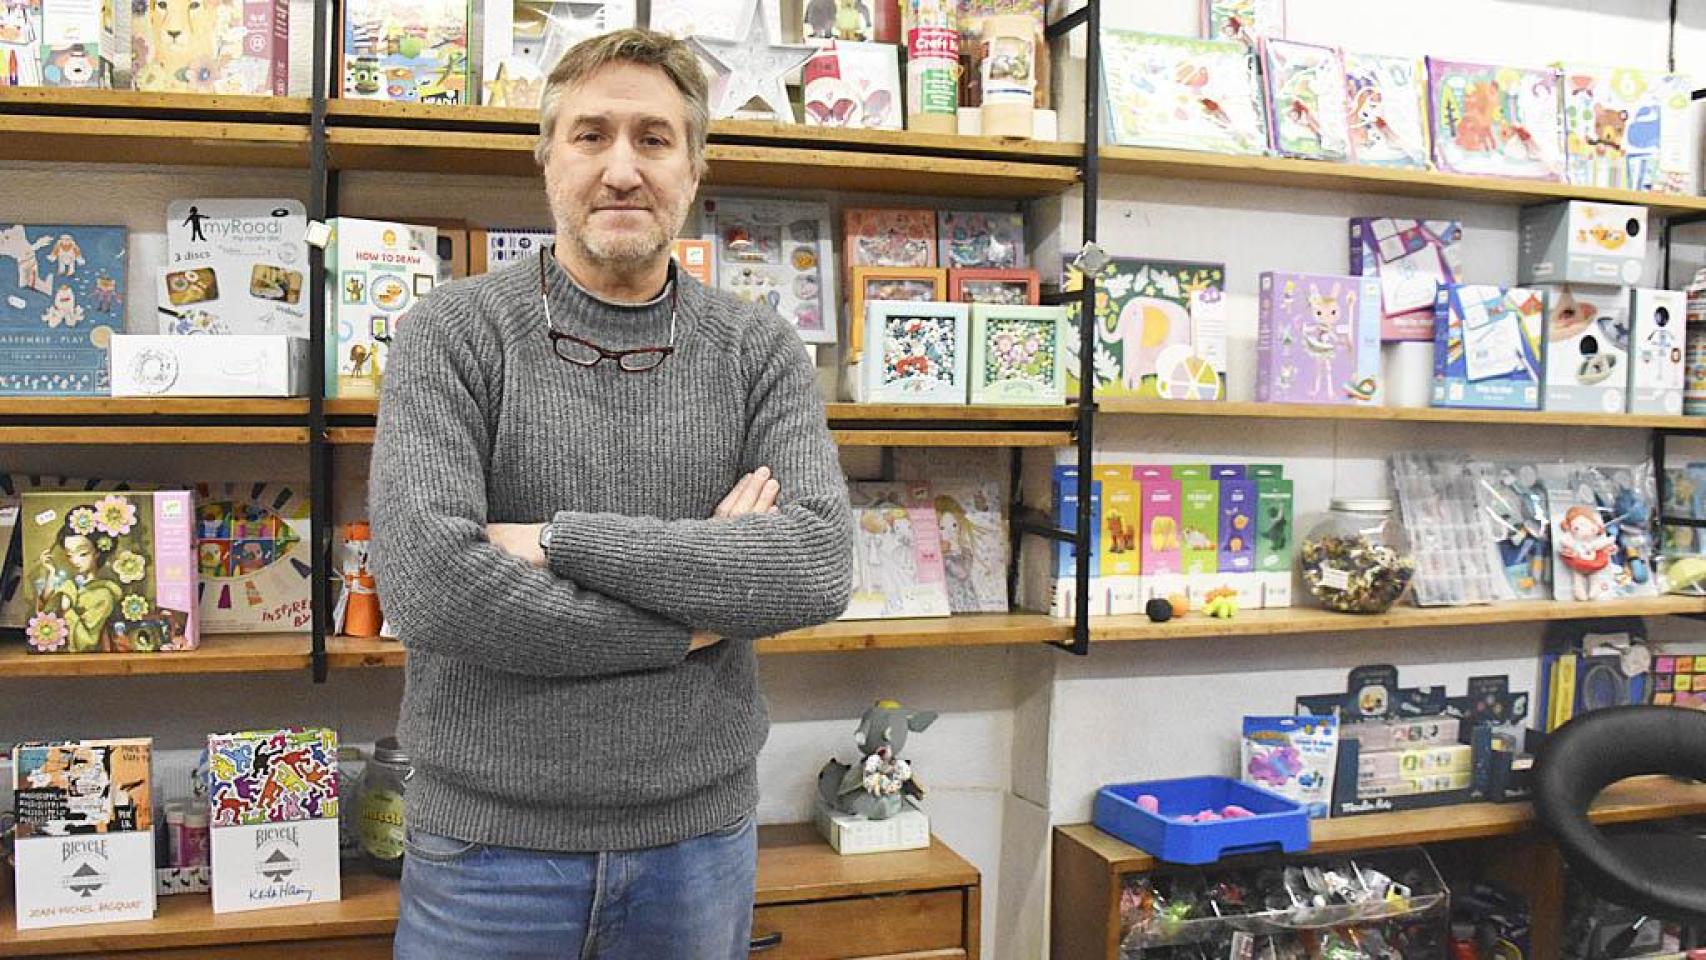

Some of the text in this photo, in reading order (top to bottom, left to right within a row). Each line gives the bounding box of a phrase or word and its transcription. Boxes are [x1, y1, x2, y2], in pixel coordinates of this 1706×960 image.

[355, 250, 421, 264] HOW TO DRAW
[255, 826, 300, 849] BICYCLE
[62, 839, 109, 862] BICYCLE
